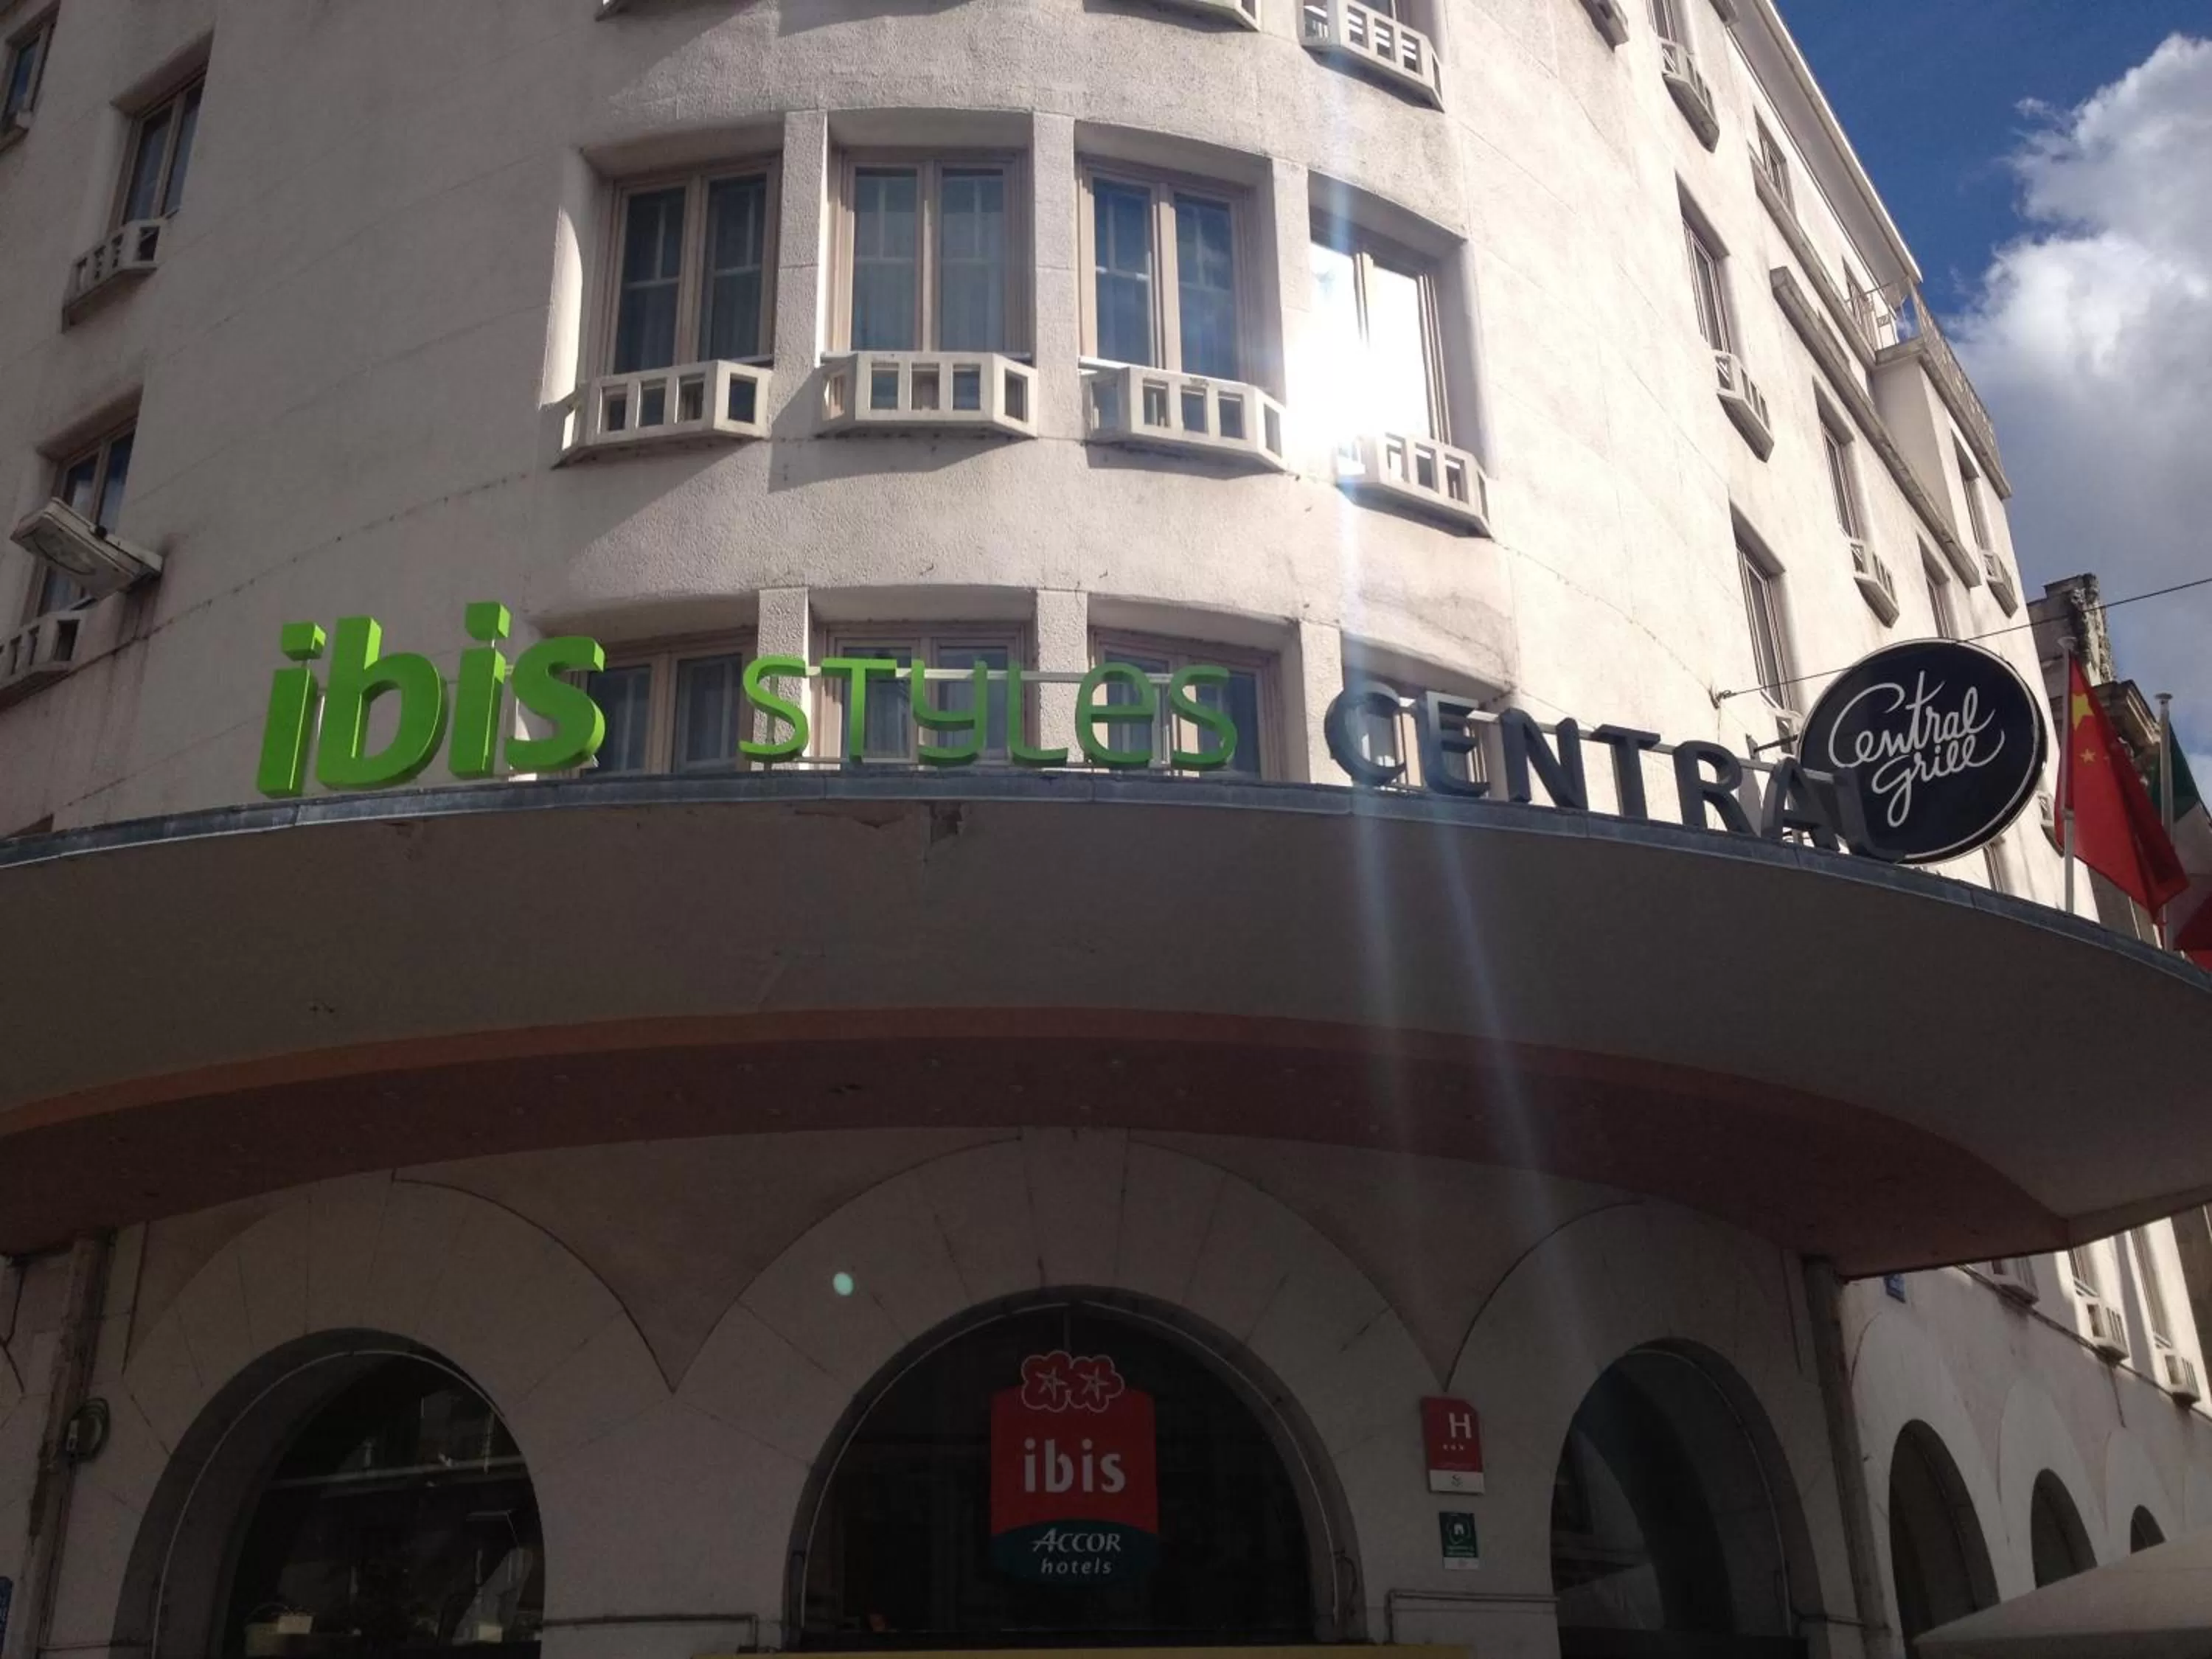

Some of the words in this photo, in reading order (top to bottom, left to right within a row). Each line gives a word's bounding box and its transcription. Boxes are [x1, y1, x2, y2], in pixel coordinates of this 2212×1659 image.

[256, 602, 605, 798] ibis
[1324, 681, 1906, 863] CENTRAL
[1828, 670, 1996, 768] Central
[1448, 1412, 1472, 1439] H
[1023, 1438, 1127, 1494] ibis
[1032, 1527, 1121, 1553] ACCOR
[1040, 1557, 1113, 1576] hotels
